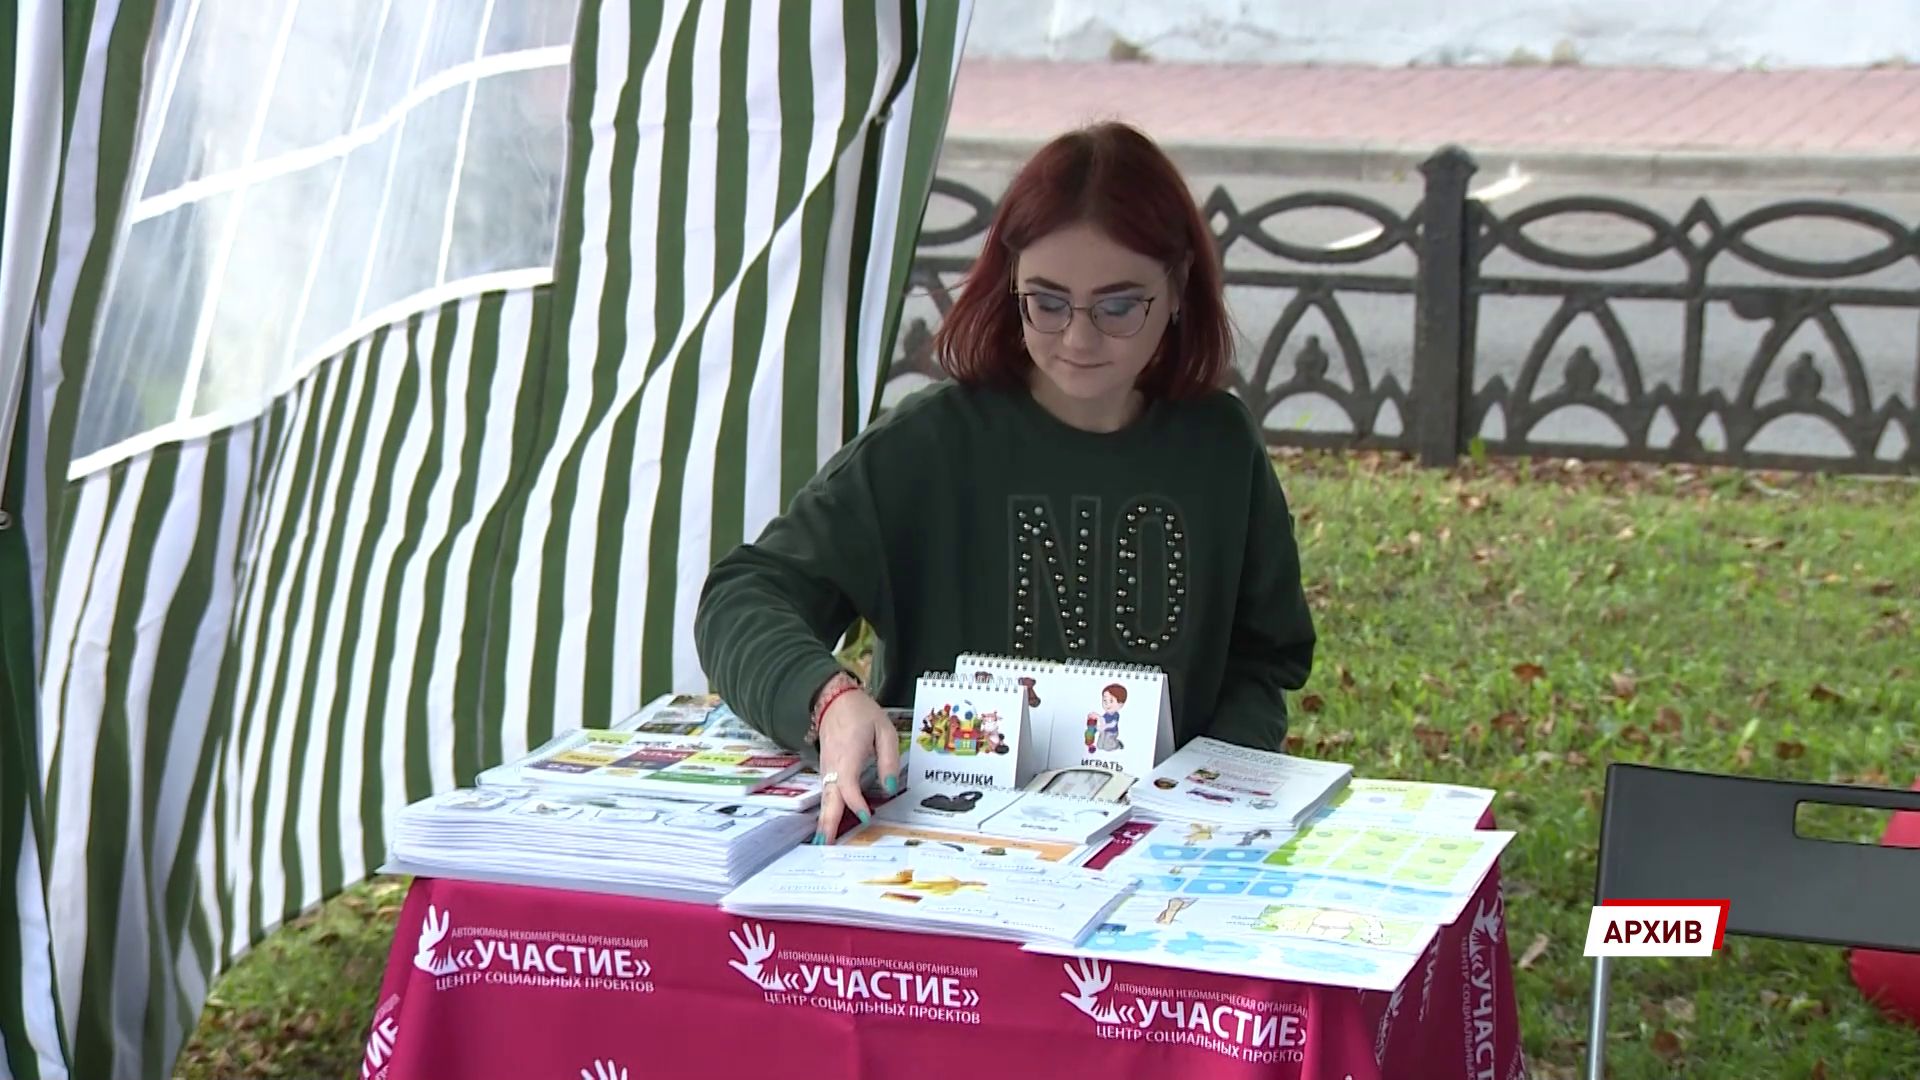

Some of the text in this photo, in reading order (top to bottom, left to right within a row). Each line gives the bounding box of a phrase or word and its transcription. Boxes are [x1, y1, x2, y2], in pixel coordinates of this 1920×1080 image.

[1008, 494, 1189, 656] NO
[924, 768, 994, 786] ИГРУШКИ
[1080, 758, 1124, 771] ИГРАТЬ
[451, 927, 508, 939] АВТОНОМНАЯ
[588, 935, 649, 948] ОРГАНИЗАЦИЯ
[456, 938, 651, 978] «УЧАСТИЕ»
[777, 950, 978, 978] АВТОНОМНАЯ НЕКОММЕРЧЕСКАЯ ОРГАНИЗАЦИЯ
[436, 970, 655, 993] ЦЕНТР СОЦИАЛЬНЫХ ПРОЕКТОВ
[783, 964, 980, 1008] «УЧАСТИЕ»
[764, 991, 981, 1025] ЦЕНТР СОЦИАЛЬНЫХ ПРОЕКТОВ
[1113, 982, 1174, 998] АВТОНОМНАЯ
[1176, 989, 1256, 1010] НЕКОММЕРЧЕСКАЯ
[1096, 1025, 1142, 1041] ЦЕНТР
[1145, 1031, 1239, 1058] СОЦИАЛЬНЫХ
